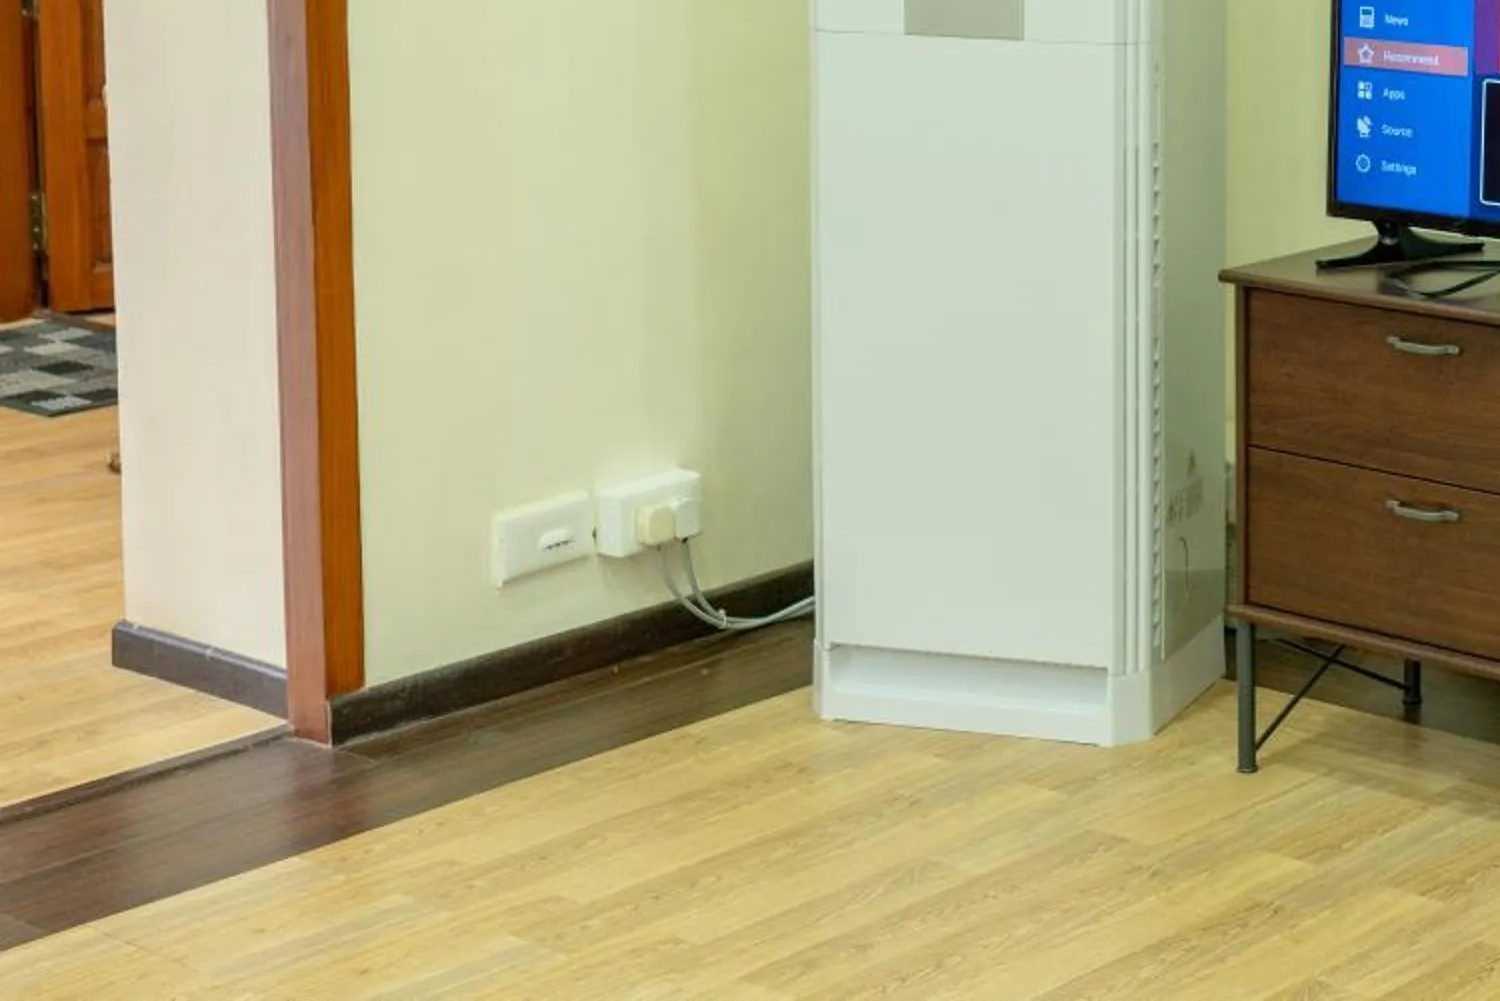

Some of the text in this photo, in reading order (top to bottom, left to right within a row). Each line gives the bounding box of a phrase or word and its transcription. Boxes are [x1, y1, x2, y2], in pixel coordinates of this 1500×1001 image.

[1384, 13, 1409, 27] News
[1383, 50, 1440, 67] Recommend
[1383, 87, 1406, 102] Apps
[1381, 123, 1414, 138] Source
[1381, 159, 1418, 176] Settings
